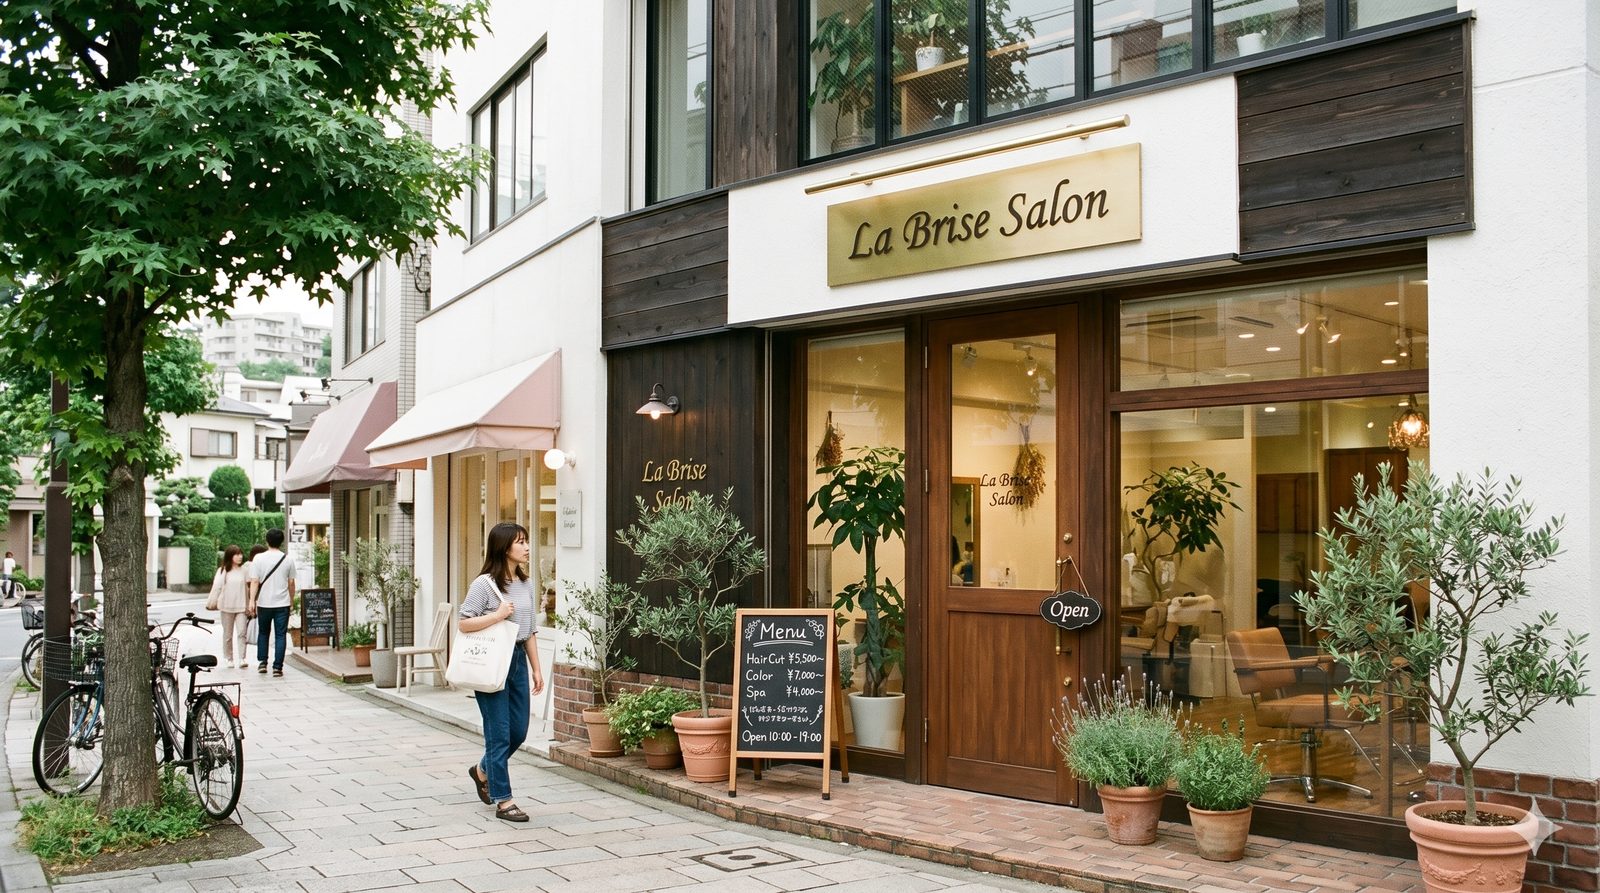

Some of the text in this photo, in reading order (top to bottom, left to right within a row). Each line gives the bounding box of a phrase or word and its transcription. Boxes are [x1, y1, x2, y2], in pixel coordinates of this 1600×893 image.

[848, 178, 1109, 260] La Brise Salon
[641, 457, 707, 482] La Brise
[979, 472, 1031, 487] La Brise
[989, 490, 1024, 507] Salon
[1050, 600, 1089, 622] Open
[760, 622, 807, 640] Menu
[745, 669, 774, 681] Color
[746, 685, 767, 701] Spa
[742, 729, 767, 746] Open
[769, 731, 792, 742] 10:00
